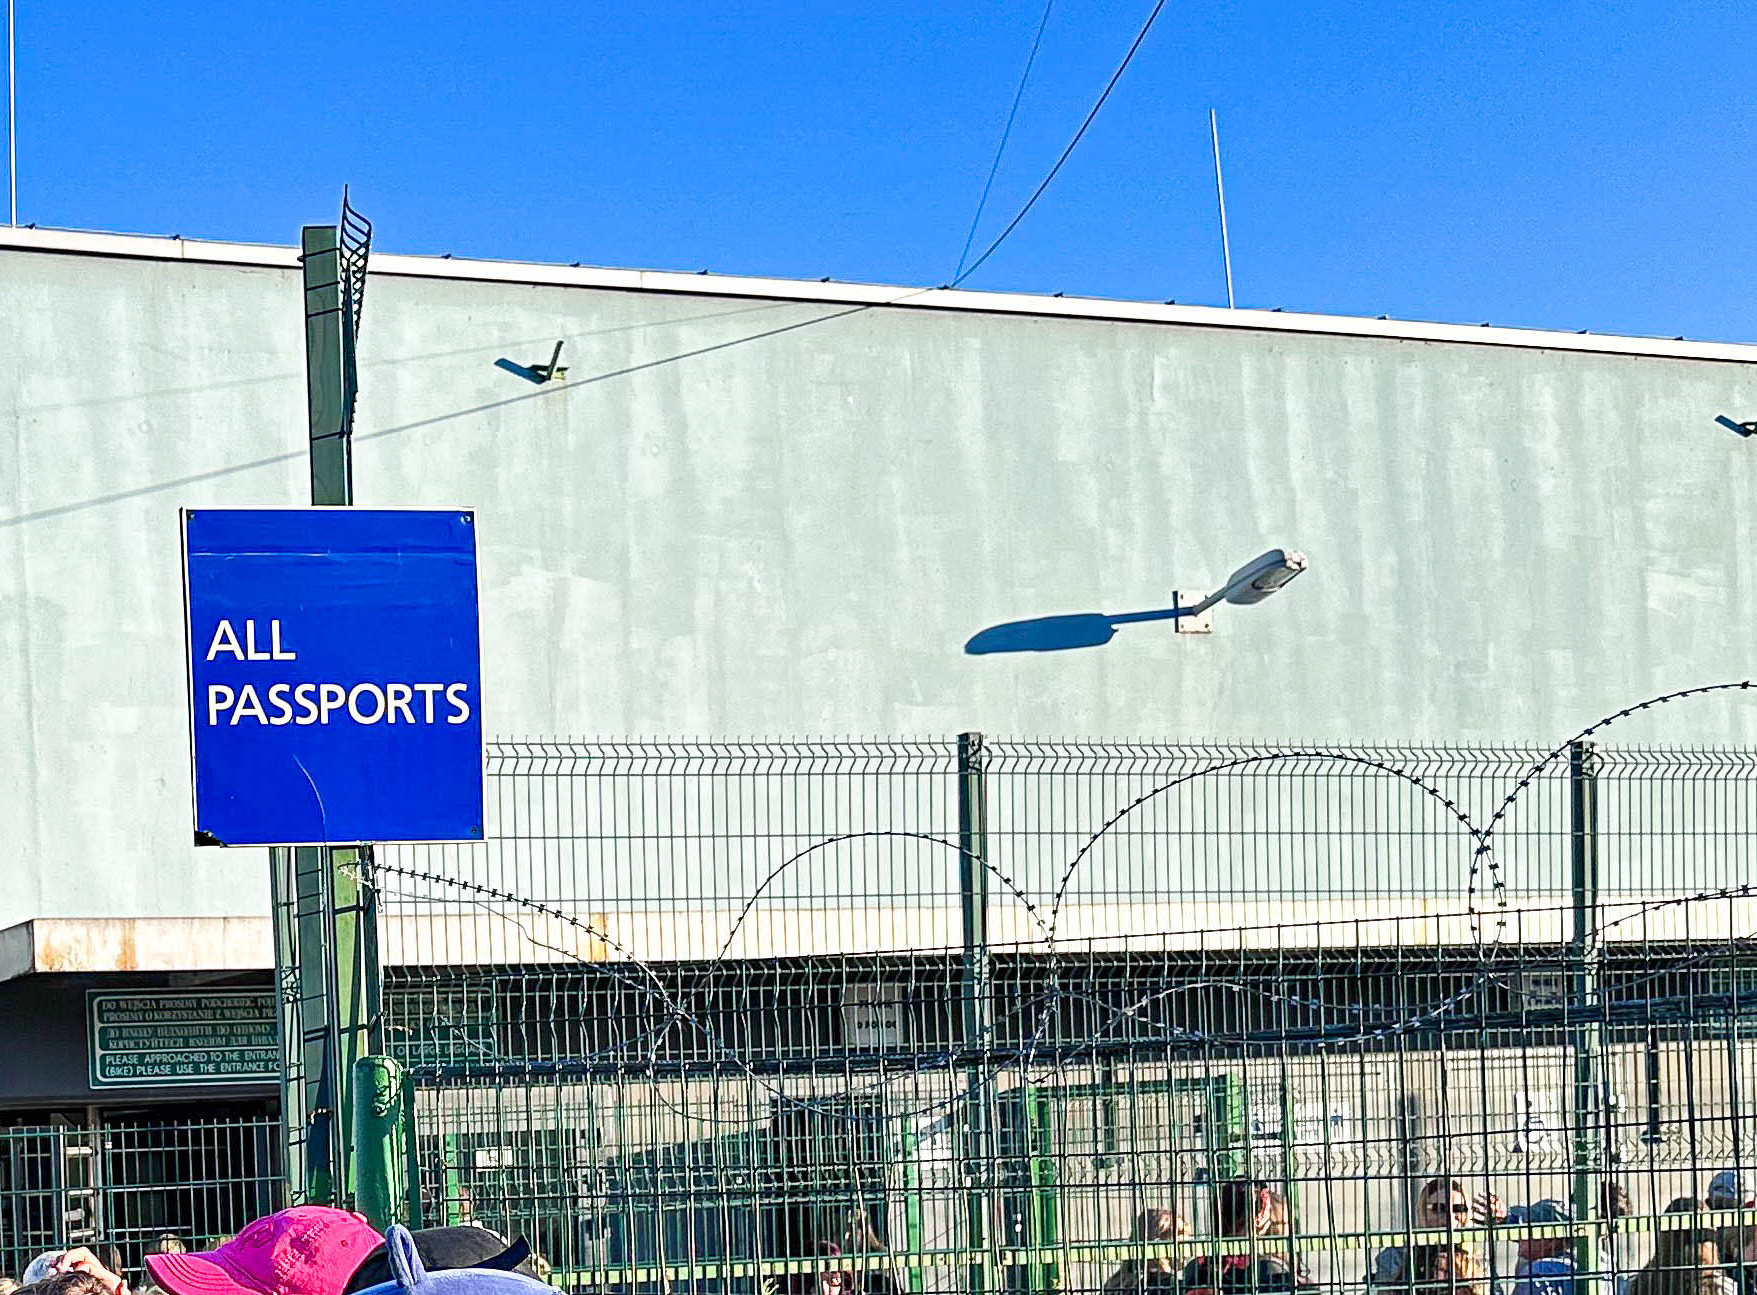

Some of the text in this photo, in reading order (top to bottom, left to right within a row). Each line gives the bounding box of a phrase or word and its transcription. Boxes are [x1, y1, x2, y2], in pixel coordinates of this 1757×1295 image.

[205, 619, 296, 661] ALL
[207, 682, 470, 726] PASSPORTS
[106, 1055, 138, 1065] PLEASE
[144, 1053, 207, 1064] APPROACHED
[210, 1052, 222, 1062] TO
[225, 1051, 240, 1061] THE
[106, 1066, 133, 1077] (BIKE)
[136, 1066, 171, 1076] PLEASE
[176, 1065, 194, 1074] USE
[200, 1064, 216, 1073] THE
[220, 1062, 265, 1072] ENTRANCE
